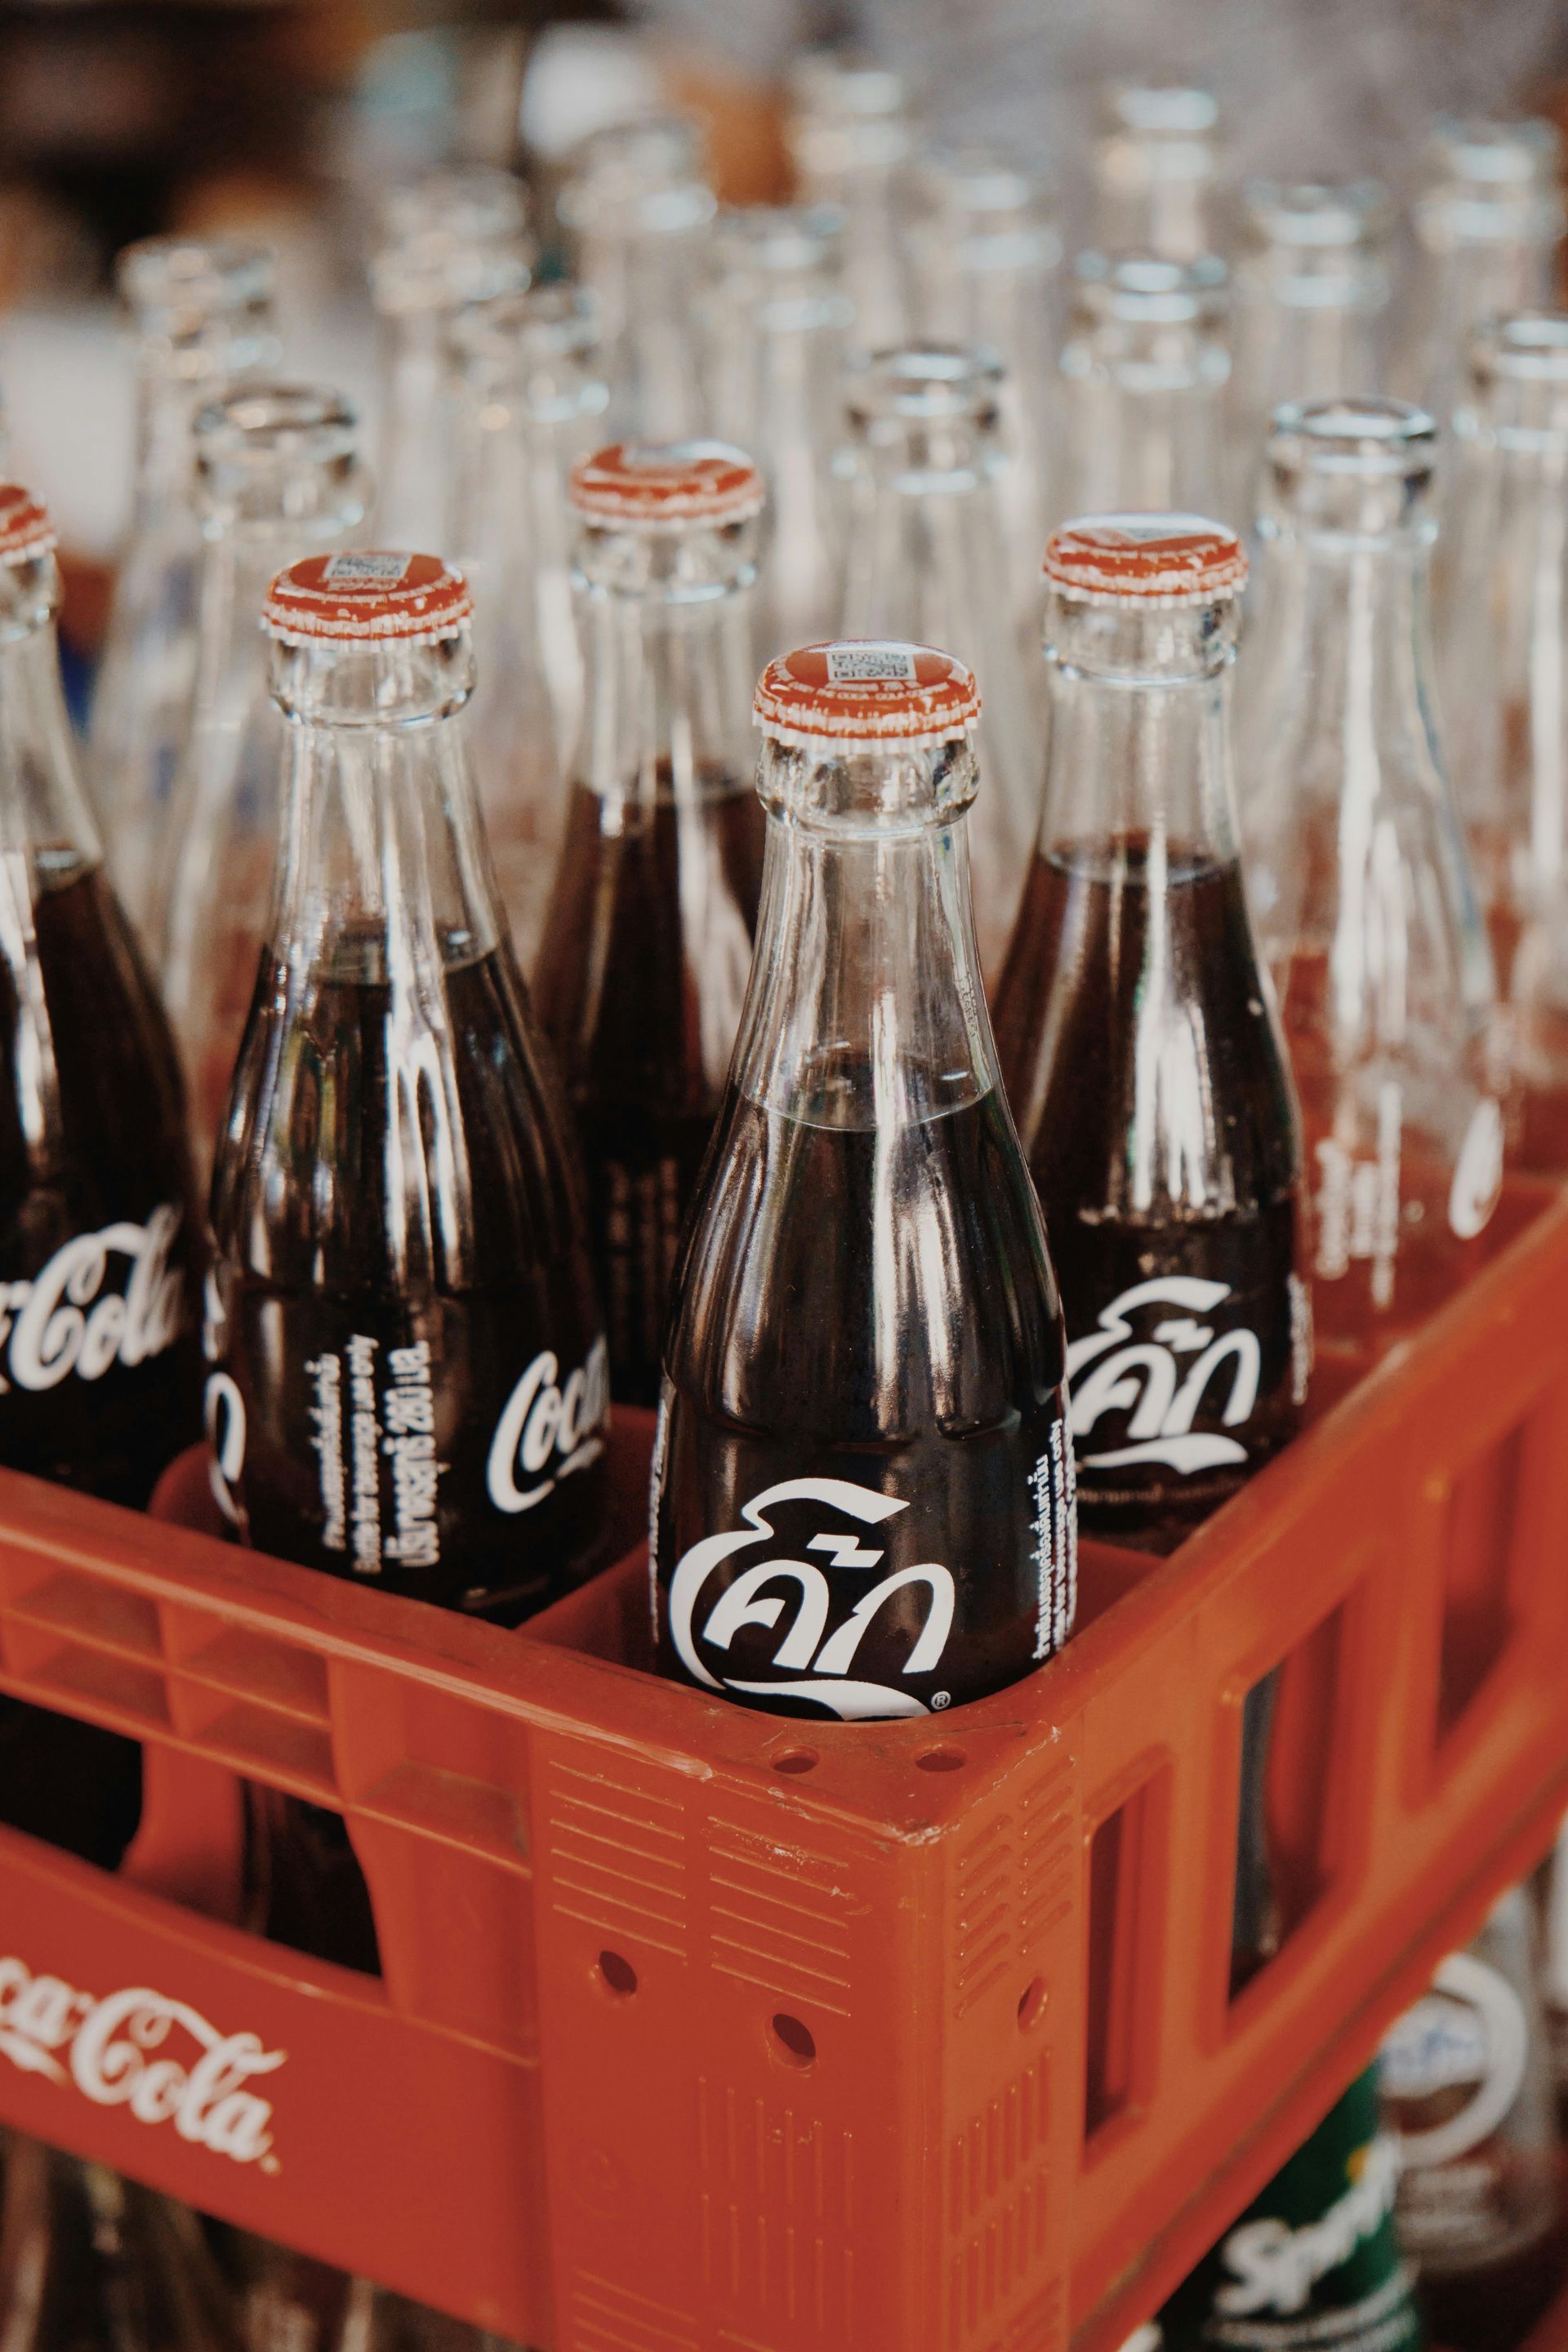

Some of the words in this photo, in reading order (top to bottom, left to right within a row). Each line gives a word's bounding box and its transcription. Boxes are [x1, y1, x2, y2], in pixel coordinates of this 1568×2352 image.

[343, 1334, 379, 1376] only
[350, 1378, 376, 1410] use
[350, 1412, 383, 1494] beverage
[1049, 1418, 1064, 1459] only
[349, 1496, 380, 1521] for
